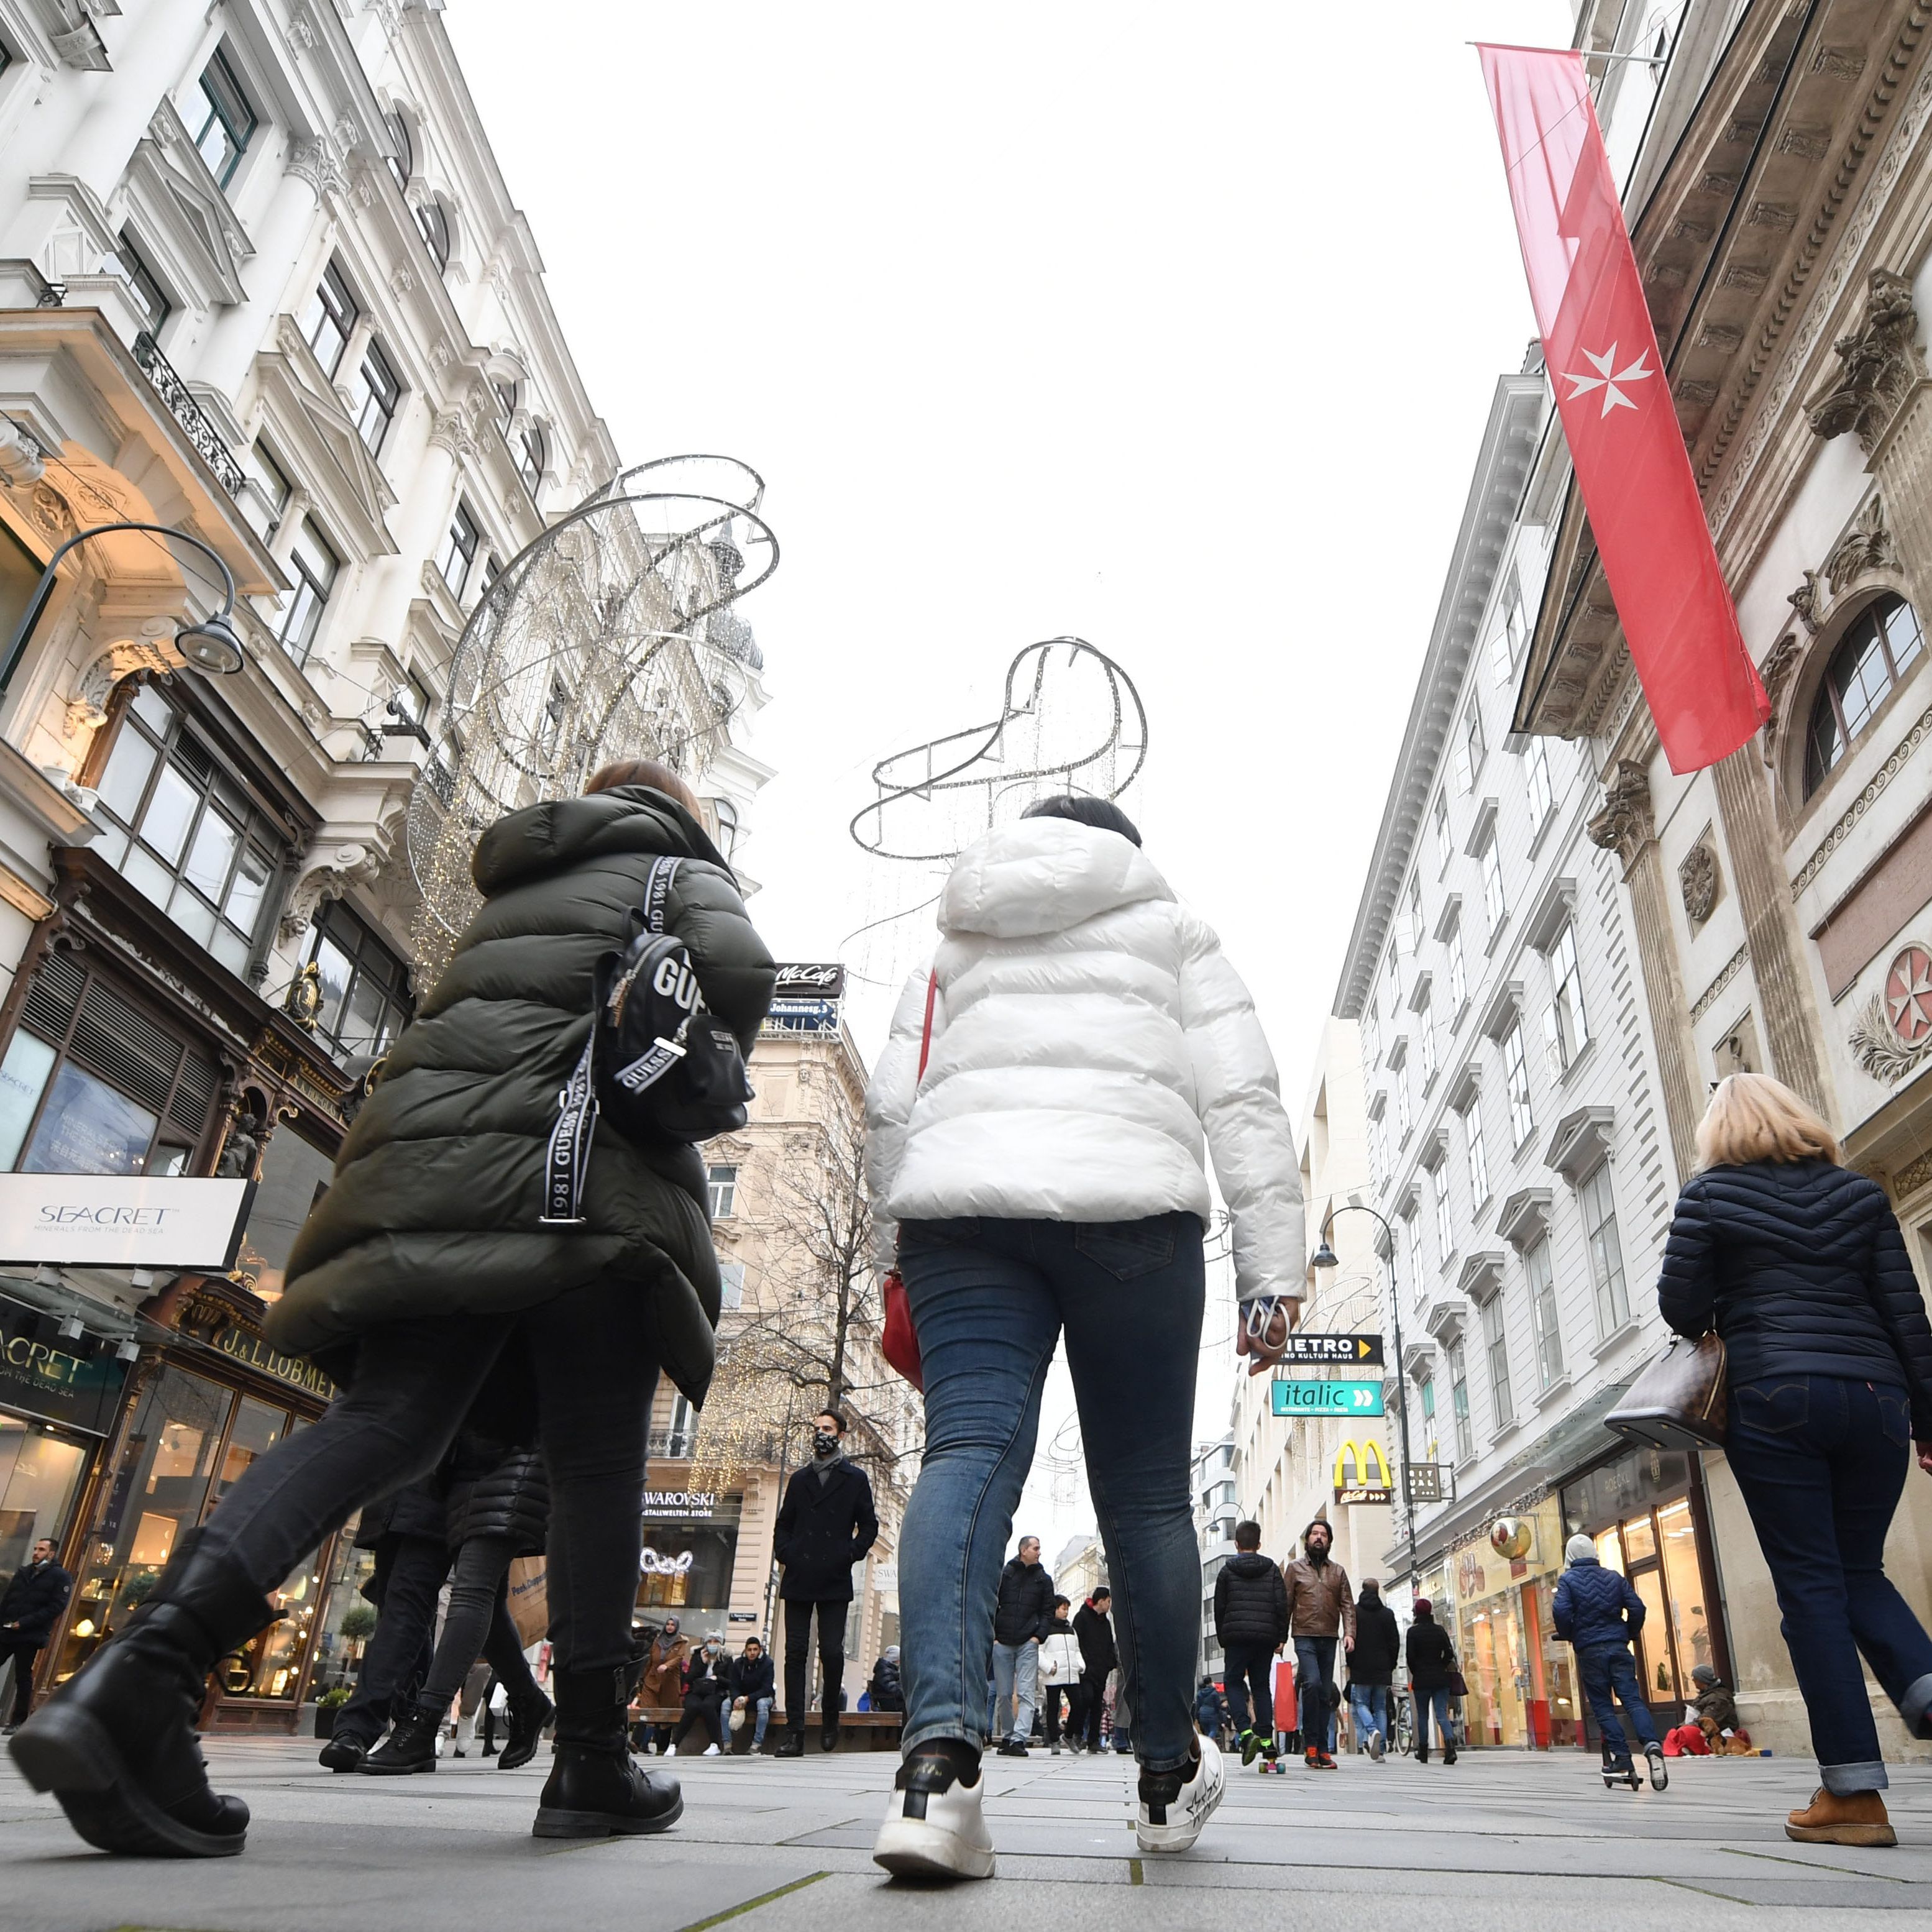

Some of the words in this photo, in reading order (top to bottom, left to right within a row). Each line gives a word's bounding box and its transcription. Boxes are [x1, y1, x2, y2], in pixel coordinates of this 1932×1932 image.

[15, 1370, 31, 1385] THE
[33, 1377, 57, 1393] DEAD
[267, 1348, 337, 1399] LOBMEY
[1285, 1385, 1344, 1406] italic
[644, 1491, 715, 1506] WAROVSKI
